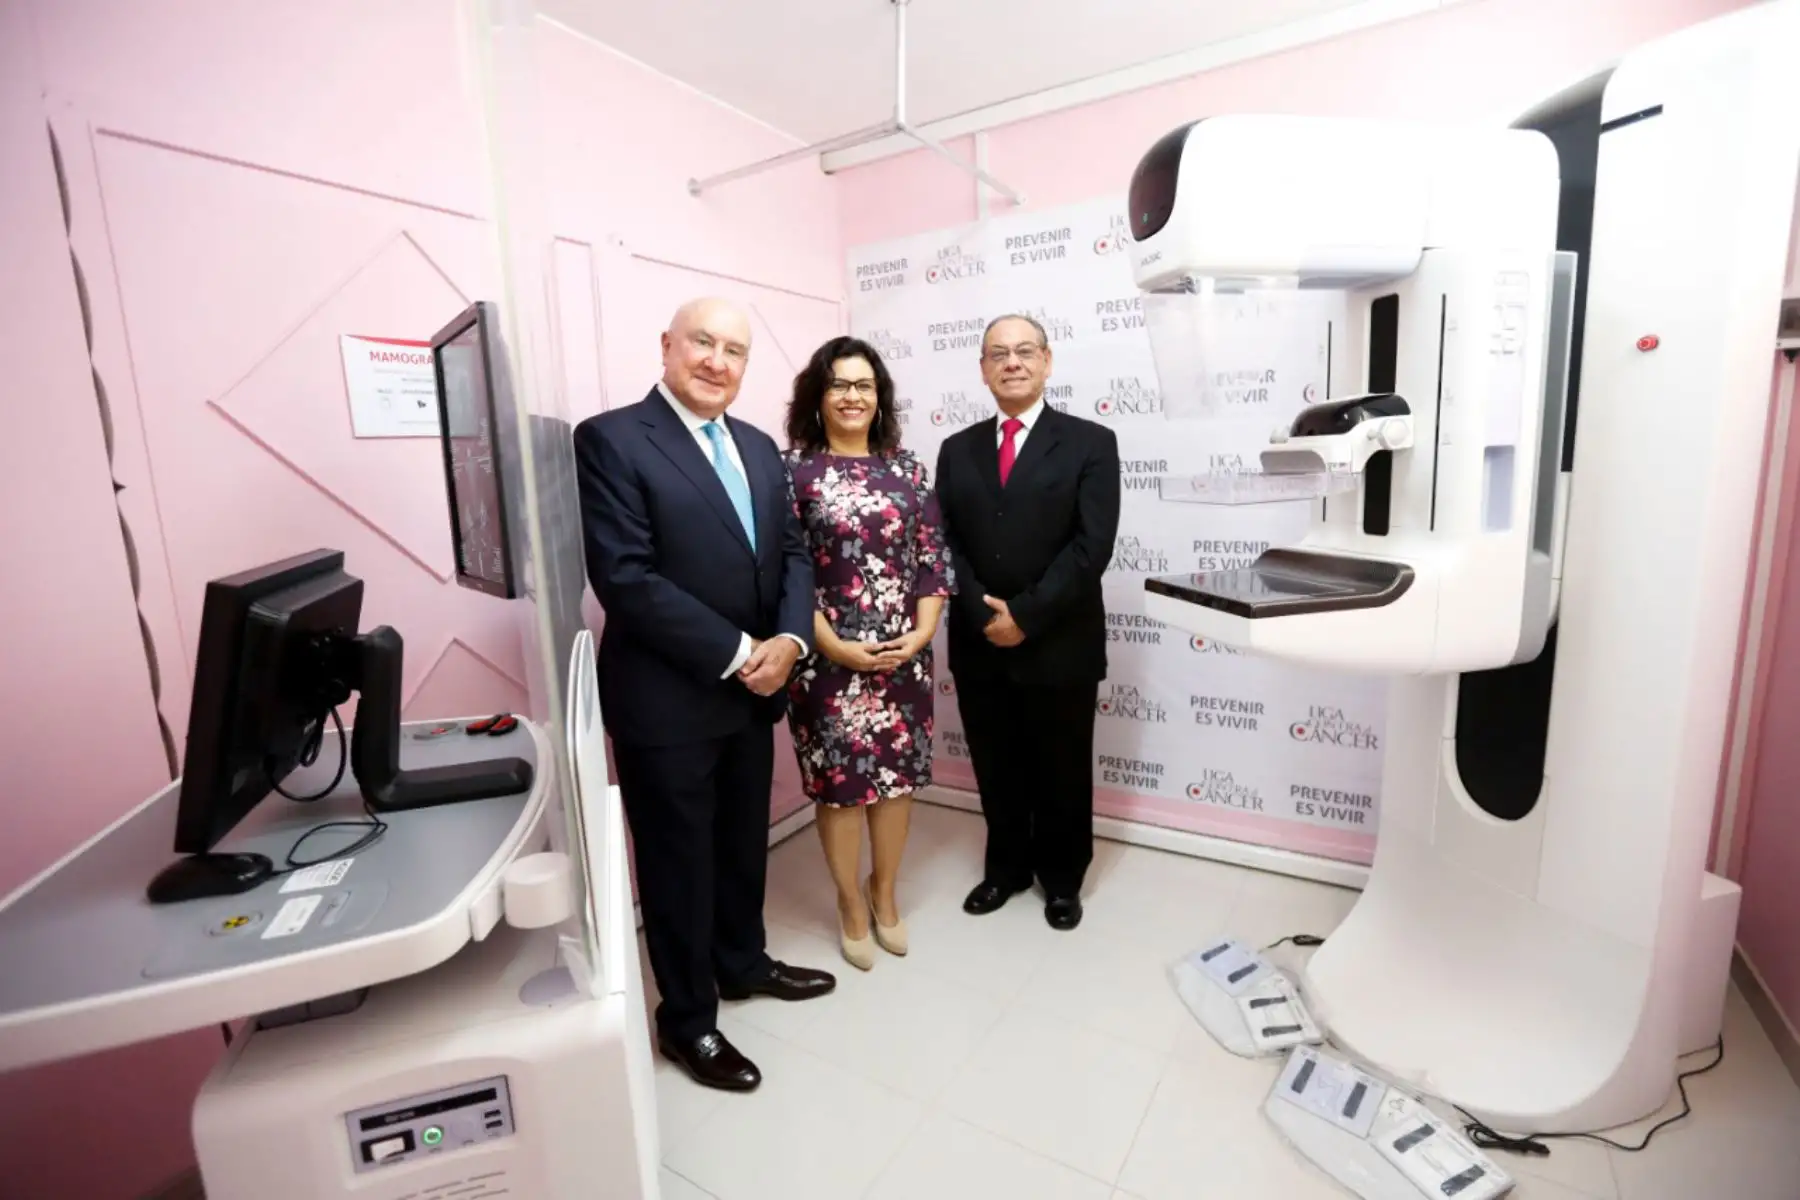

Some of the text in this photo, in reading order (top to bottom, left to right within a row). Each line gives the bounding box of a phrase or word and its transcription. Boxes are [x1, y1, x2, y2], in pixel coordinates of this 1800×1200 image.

[1006, 228, 1072, 250] PREVENIR
[1010, 246, 1066, 266] ES VIVIR
[856, 258, 908, 278] PREVENIR
[860, 274, 905, 292] ES VIVIR
[1096, 298, 1142, 314] PREVE
[928, 318, 985, 337] PREVENIR
[1102, 315, 1146, 332] ES VIV
[948, 334, 980, 349] VIVIR
[369, 350, 434, 365] MAMOGRA
[877, 346, 912, 360] NCER
[1193, 540, 1270, 554] PREVENIR
[1109, 558, 1168, 572] ANCER
[1198, 556, 1216, 570] ES
[1124, 630, 1161, 644] VIVIR
[1190, 695, 1264, 715] PREVENIR
[1196, 712, 1258, 731] ES VIVIR
[1098, 755, 1164, 776] PREVENIR
[1104, 770, 1158, 790] ES VIVIR
[1290, 784, 1372, 808] PREVENIR
[1296, 801, 1365, 824] ES VIVIR
